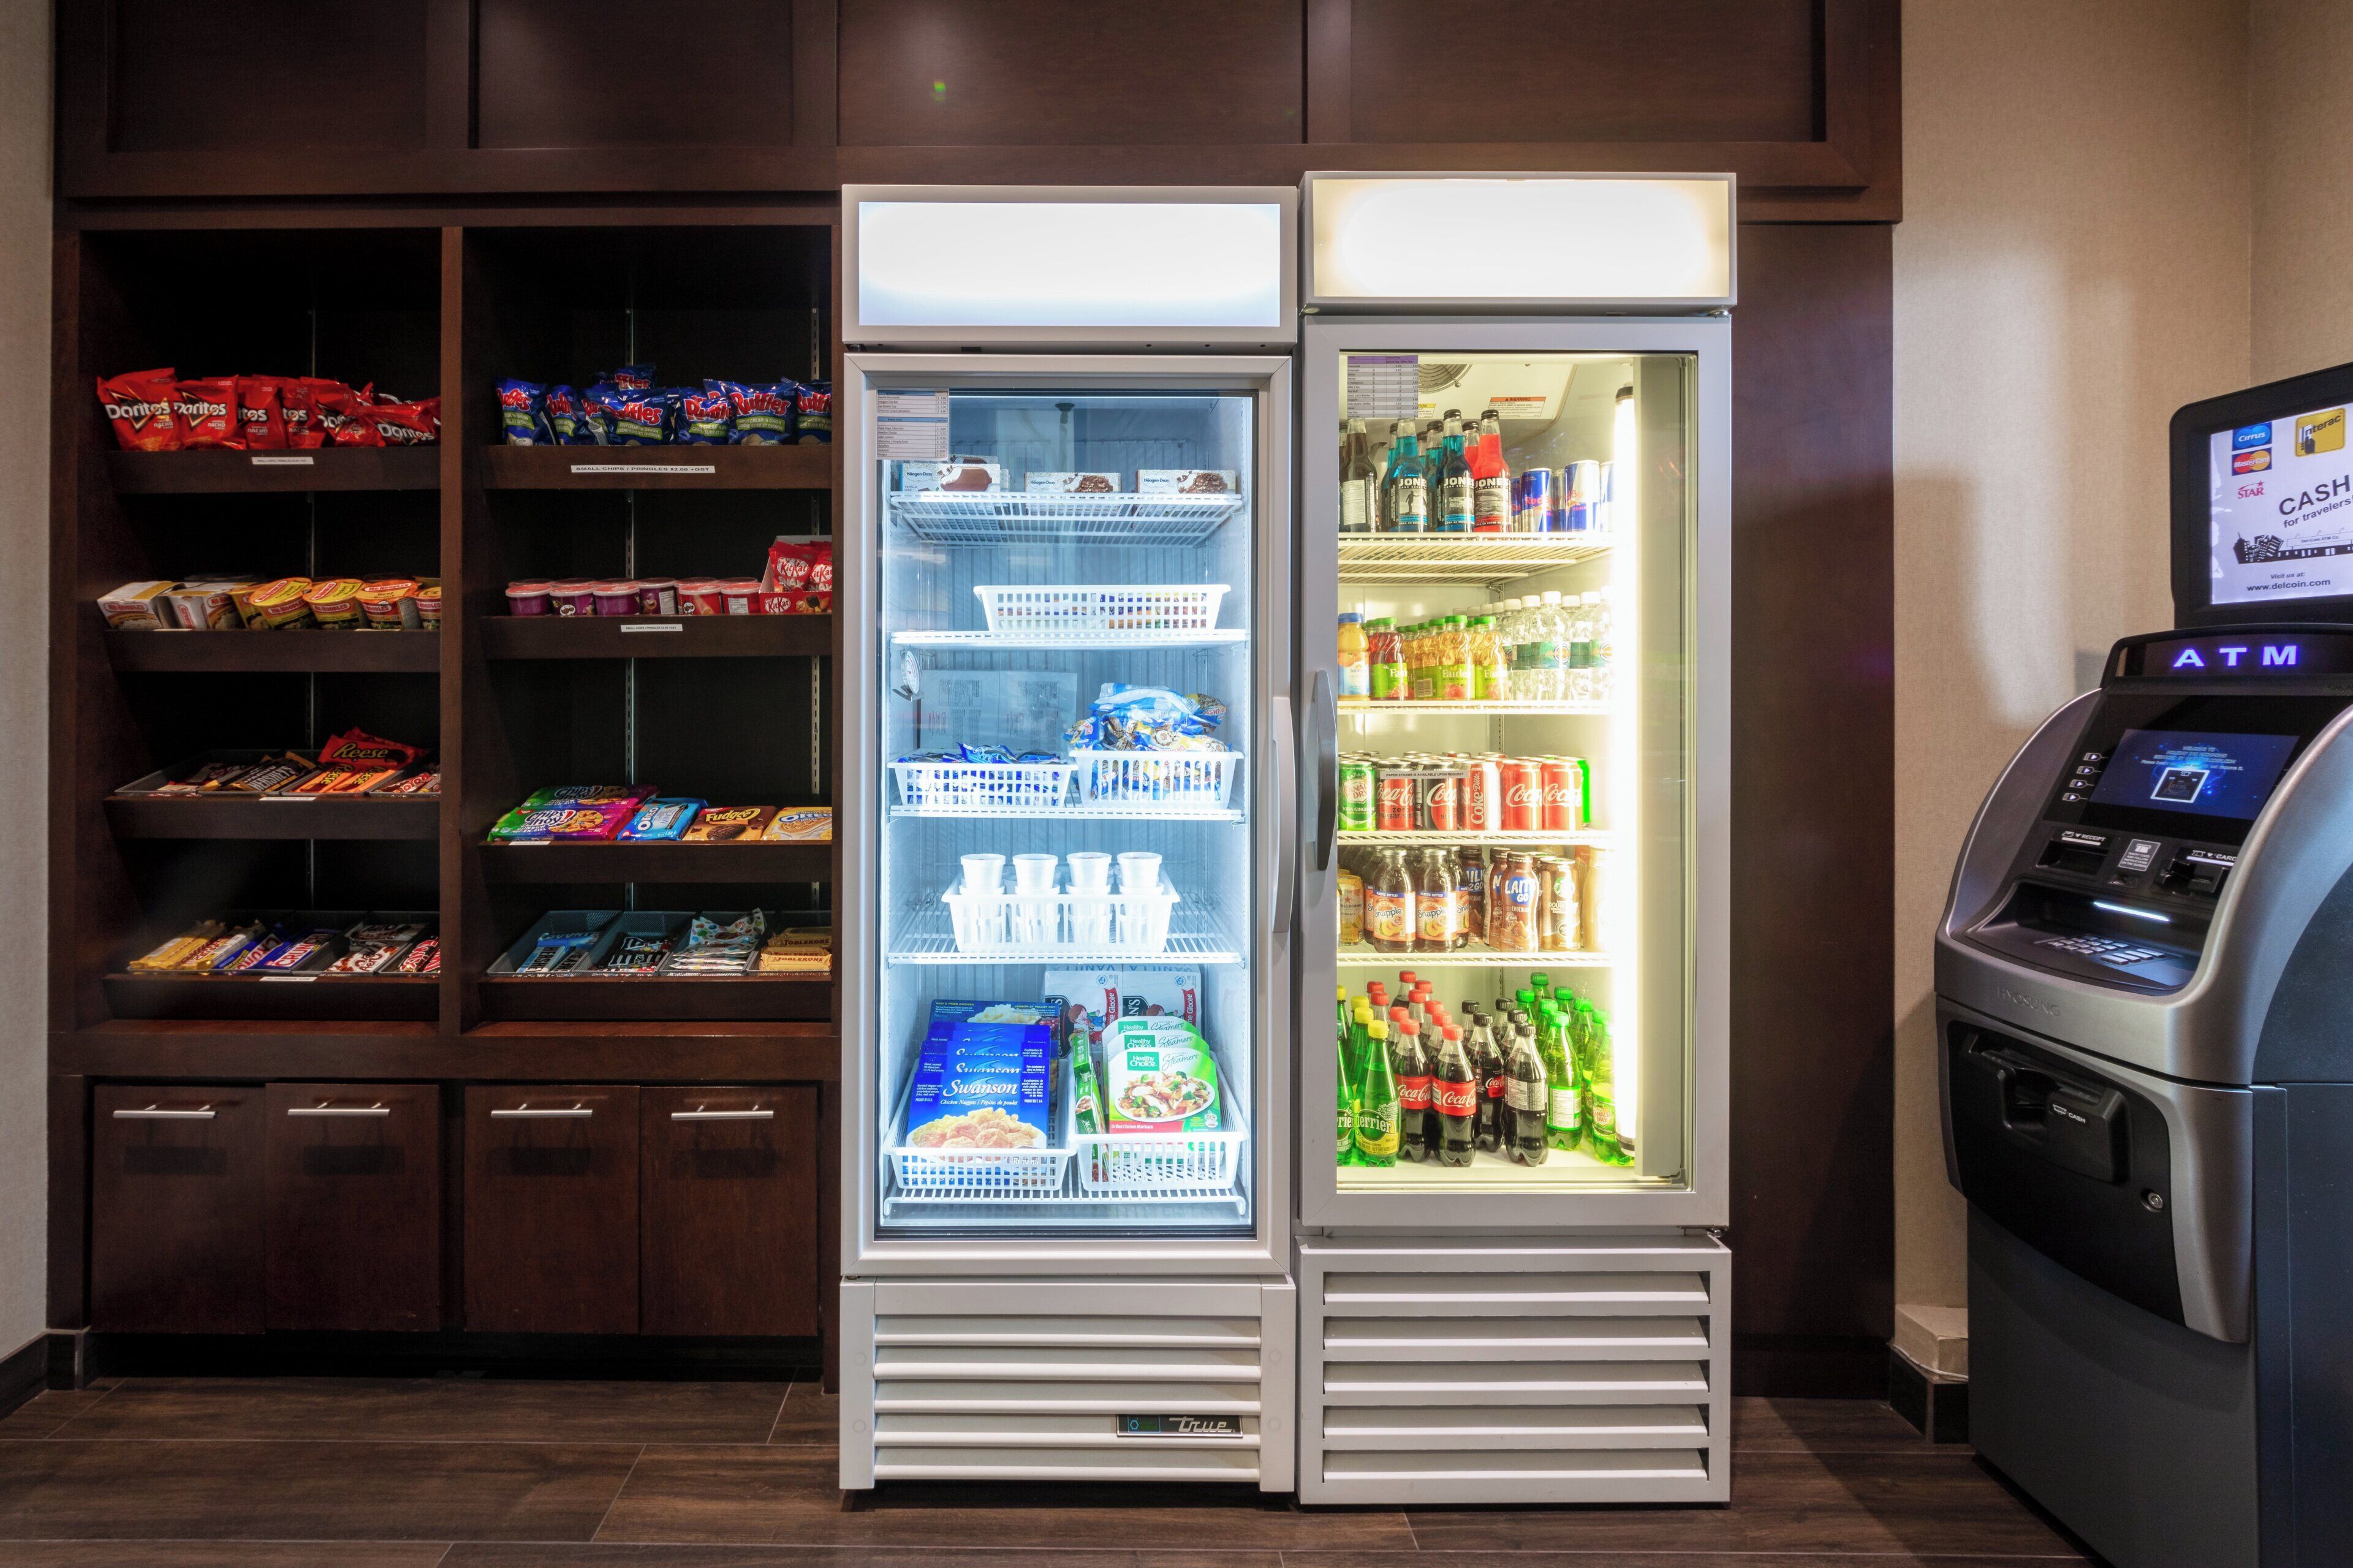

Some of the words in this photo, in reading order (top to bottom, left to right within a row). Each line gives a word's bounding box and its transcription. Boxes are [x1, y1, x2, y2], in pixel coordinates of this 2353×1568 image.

[105, 402, 171, 419] Doritos
[174, 402, 226, 415] Doritos
[729, 392, 791, 415] Ruffles
[377, 423, 436, 441] Doritos
[2238, 431, 2266, 442] Cirrus
[2234, 455, 2270, 468] MasterCard
[2237, 487, 2264, 499] STAR
[2279, 474, 2351, 516] CASH
[2283, 517, 2298, 528] for
[780, 558, 808, 577] KitKat
[2247, 580, 2331, 592] www.delcoin.com
[766, 597, 789, 613] KitKat
[2173, 645, 2298, 668] ATM
[332, 743, 388, 759] Reese
[1471, 792, 1485, 824] Coke
[525, 810, 564, 824] Chips
[1517, 893, 1530, 903] GO
[1374, 907, 1403, 918] Snapple
[1417, 907, 1447, 918] Snapple
[1997, 985, 2061, 1018] HYOSUNG
[1158, 1036, 1194, 1048] Steamers
[1161, 1053, 1199, 1071] Steamers
[942, 1079, 1018, 1097] Swanson
[2069, 1113, 2086, 1124] CASH
